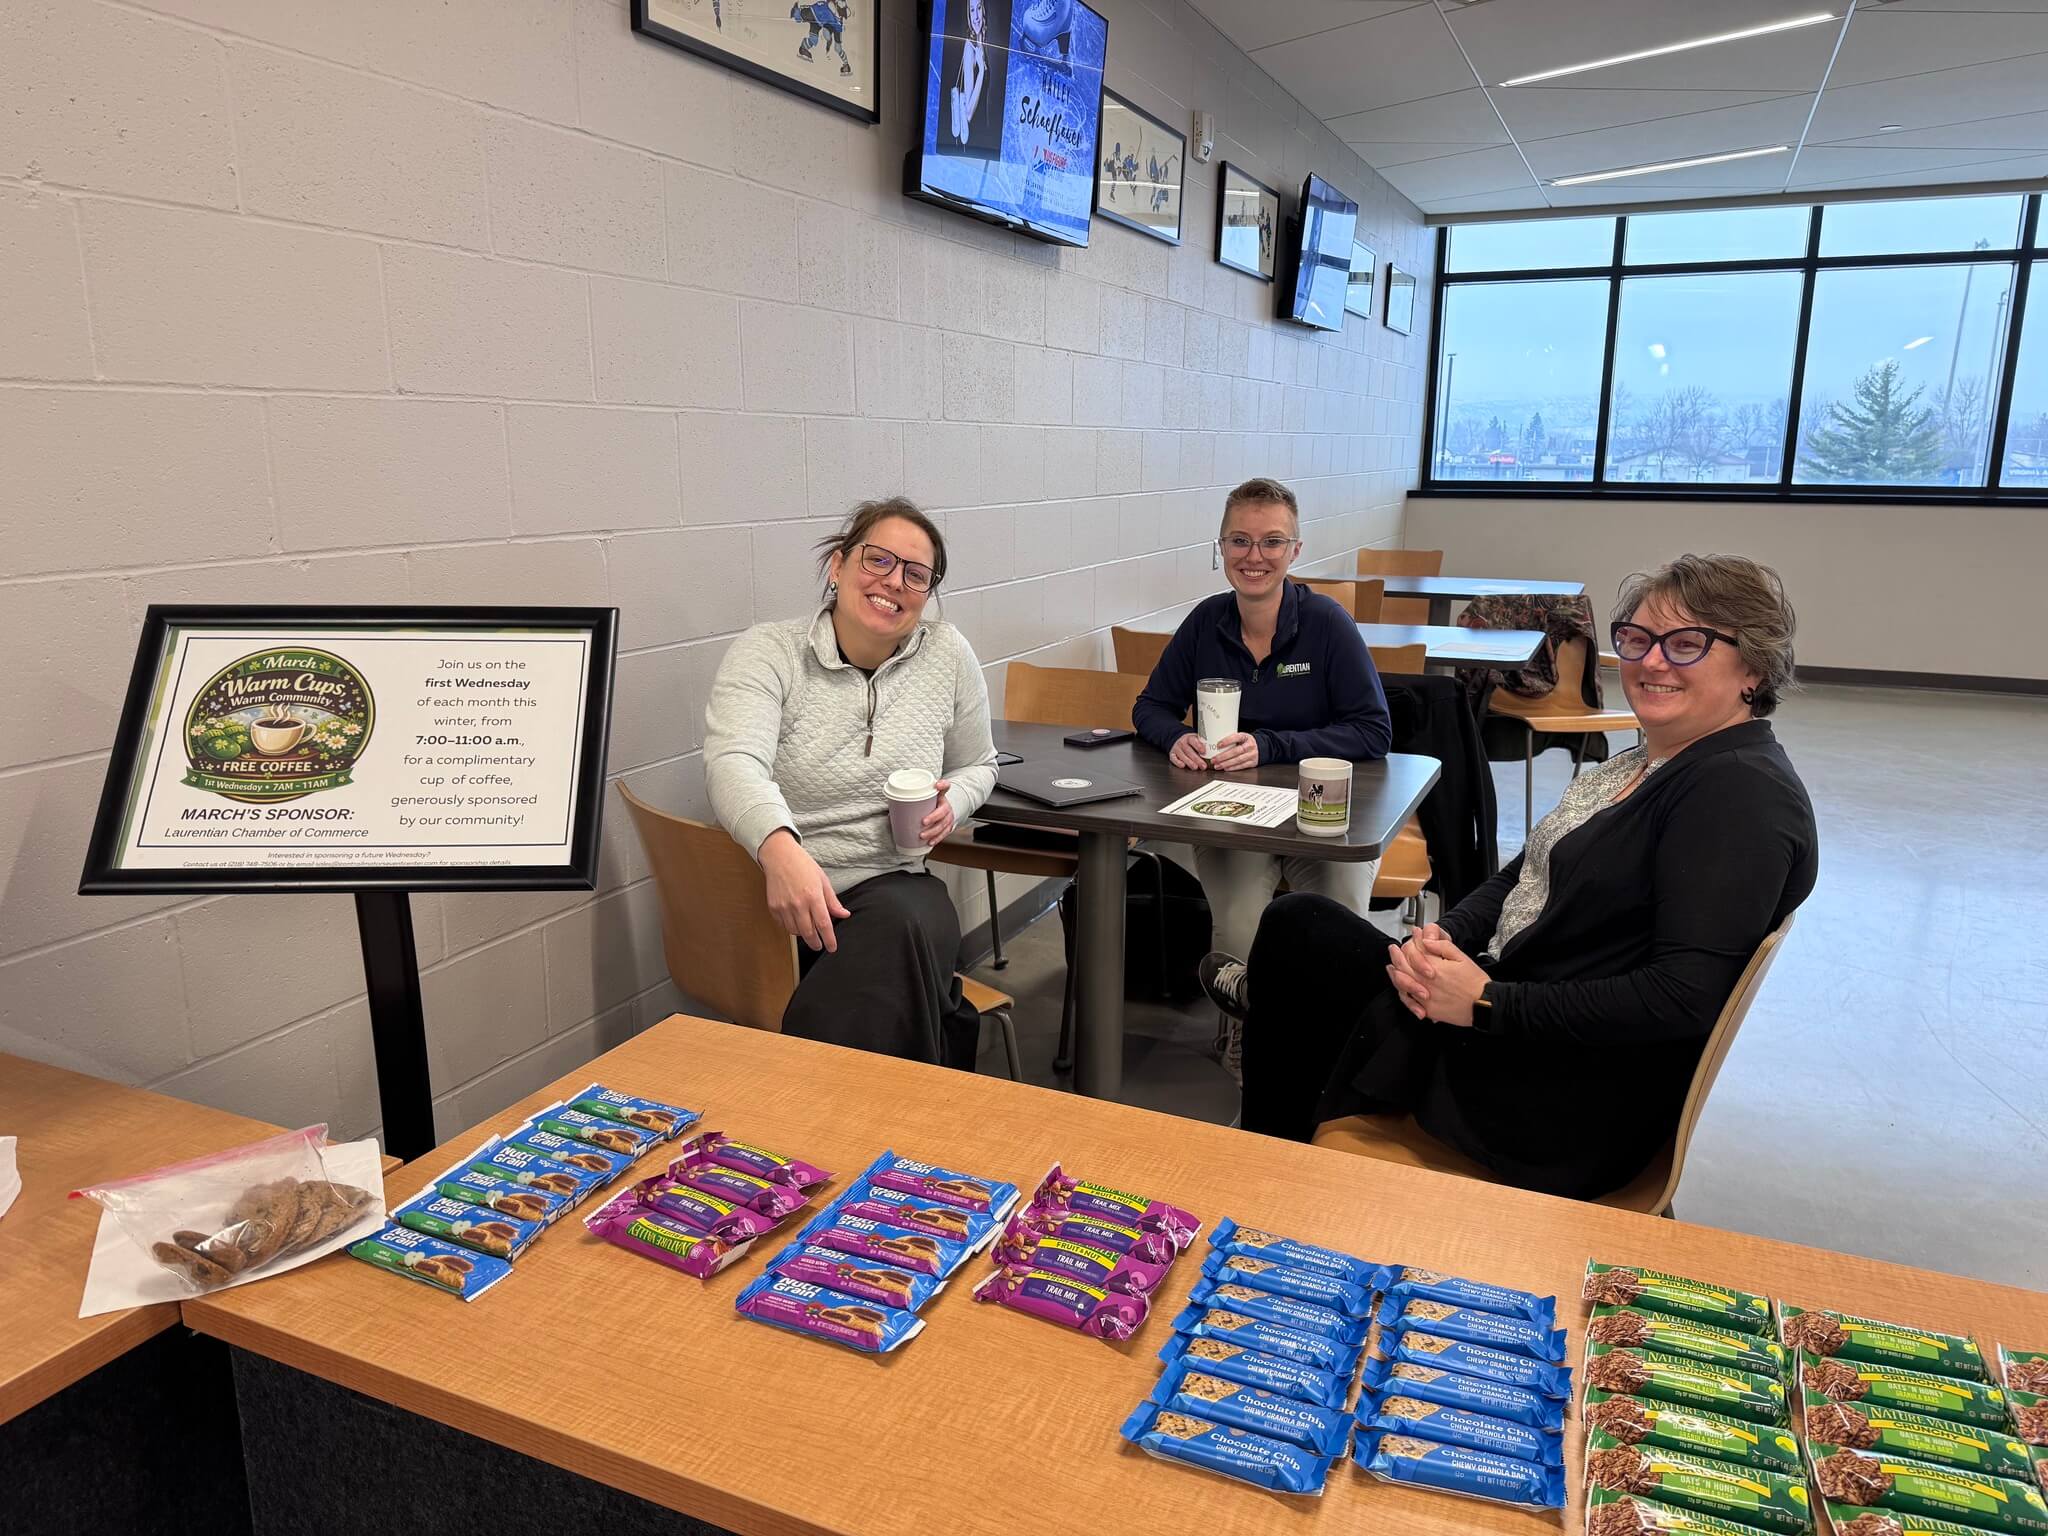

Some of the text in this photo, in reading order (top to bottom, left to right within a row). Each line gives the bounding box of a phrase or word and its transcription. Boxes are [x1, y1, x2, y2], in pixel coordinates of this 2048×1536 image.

[262, 655, 318, 670] March
[436, 659, 526, 670] Join us on the
[220, 672, 347, 698] Warm Cups,
[424, 678, 531, 690] first Wednesday
[230, 691, 333, 708] Warm Community
[416, 696, 537, 707] of each month this
[434, 716, 512, 728] winter, from
[495, 737, 525, 746] a.m.,
[222, 761, 312, 772] FREE COFFEE
[403, 754, 535, 767] for a complimentary
[204, 778, 328, 792] 1st Wednesday 7AM 11AM
[420, 774, 513, 787] cup of coffee,
[391, 794, 537, 807] generously sponsored
[180, 808, 355, 820] MARCH'S SPONSOR:
[399, 814, 524, 828] by our community!
[164, 827, 369, 838] Laurentian Chamber of Commerce
[314, 852, 353, 861] sponsoring
[361, 851, 384, 859] future
[385, 851, 431, 859] Wednesday?
[597, 1093, 629, 1105] Grain
[558, 1113, 592, 1124] Grain
[528, 1135, 561, 1148] Grain
[536, 1131, 569, 1144] Nutri
[492, 1153, 528, 1168] Grain
[500, 1146, 539, 1162] Nutri
[893, 1162, 933, 1175] Grain
[899, 1158, 937, 1170] Nutri
[459, 1175, 497, 1188] Grain
[427, 1203, 465, 1217] Grain
[434, 1197, 476, 1212] Nutri
[1092, 1198, 1121, 1211] TRAIL MIX
[842, 1213, 881, 1226] Nutri
[390, 1227, 432, 1243] Nutri
[628, 1223, 692, 1255] NATURE VALLEY
[1083, 1225, 1114, 1238] TRAIL MIX
[380, 1232, 420, 1248] Grain
[1057, 1254, 1089, 1270] TRAIL MIX
[1643, 1268, 1690, 1284] NATURE
[772, 1282, 818, 1298] Grain
[778, 1277, 824, 1293] Nutri
[1045, 1284, 1079, 1301] TRAIL MIX
[1452, 1280, 1507, 1296] Chocolate
[1659, 1279, 1714, 1295] CRUNCHY
[1459, 1313, 1516, 1331] Chocolate
[1652, 1312, 1745, 1341] NATURE VALLEY
[1254, 1324, 1335, 1356] Chocolate Chip
[1668, 1323, 1727, 1341] CRUNCHY
[1242, 1354, 1298, 1374] Chocolate
[1648, 1351, 1746, 1381] NATURE VALLEY
[1666, 1364, 1727, 1383] CRUNCHY
[1881, 1374, 1945, 1389] CRUNCHY
[1237, 1393, 1326, 1430] Chocolate Chip
[1243, 1405, 1311, 1430] CHEWY GRANOLA BAR
[1649, 1398, 1751, 1431] NATURE VALLEY
[1440, 1412, 1504, 1432] Chocolate
[1870, 1406, 1978, 1440] NATURE VALLEY
[1450, 1422, 1522, 1443] CHEWY GRANOLA BAR
[1893, 1421, 1960, 1440] CRUNCHY
[1210, 1432, 1301, 1472] Chocolate Chip
[1215, 1443, 1285, 1470] CHEWY GRANOLA BAR
[1441, 1449, 1507, 1468] Chocolate
[1452, 1459, 1527, 1481] CHEWY GRANOLA BAR
[1655, 1448, 1766, 1484] NATURE VALLEY
[1906, 1467, 1976, 1487] CRUNCHY
[1713, 1480, 1740, 1496] HONEY
